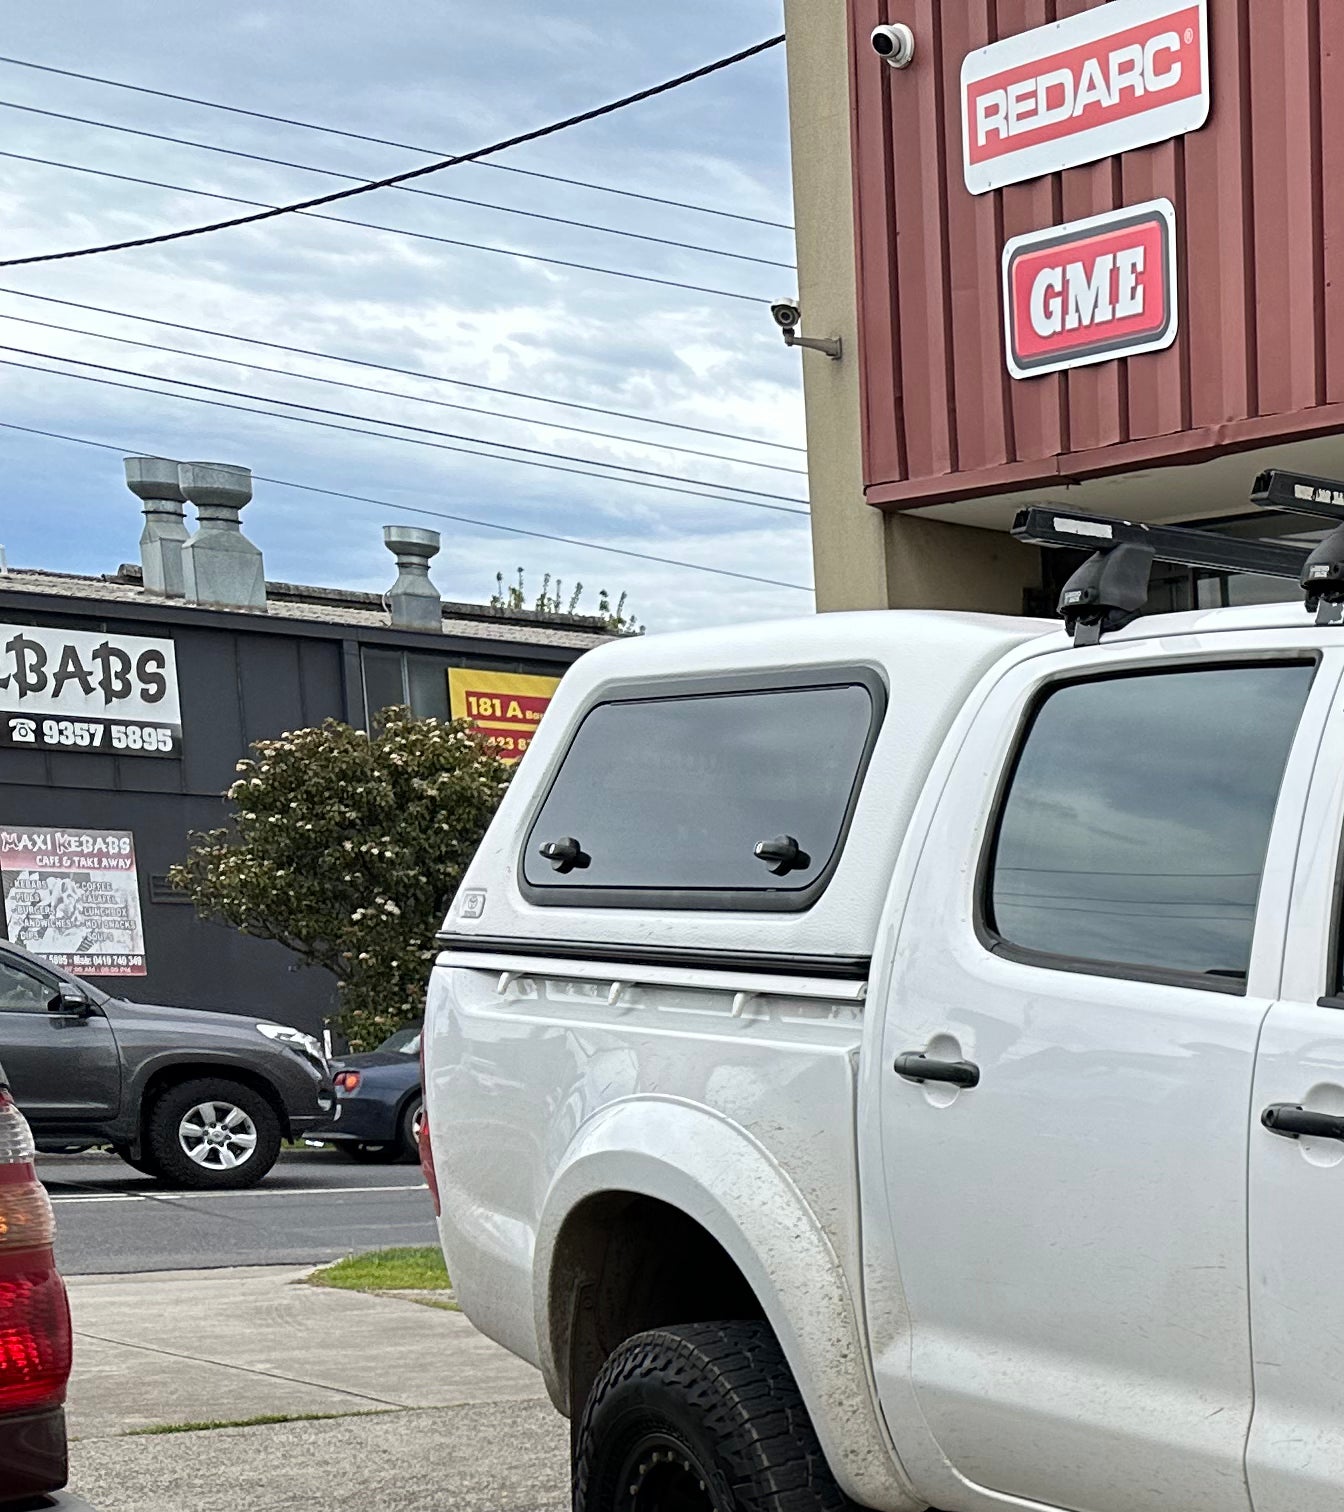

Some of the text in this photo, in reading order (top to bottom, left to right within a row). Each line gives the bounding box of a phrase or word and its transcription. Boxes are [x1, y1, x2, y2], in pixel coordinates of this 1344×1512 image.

[976, 31, 1182, 147] REDARC
[1030, 245, 1145, 337] GME
[0, 633, 167, 706] BABS
[468, 697, 502, 717] 181
[506, 700, 523, 719] A
[42, 720, 173, 752] 9357 5895
[1, 831, 130, 855] MAXI KEBABS
[36, 855, 60, 867] CAFE
[72, 856, 99, 868] TAKE
[101, 858, 131, 869] AWAY
[81, 881, 112, 892] COFFEE
